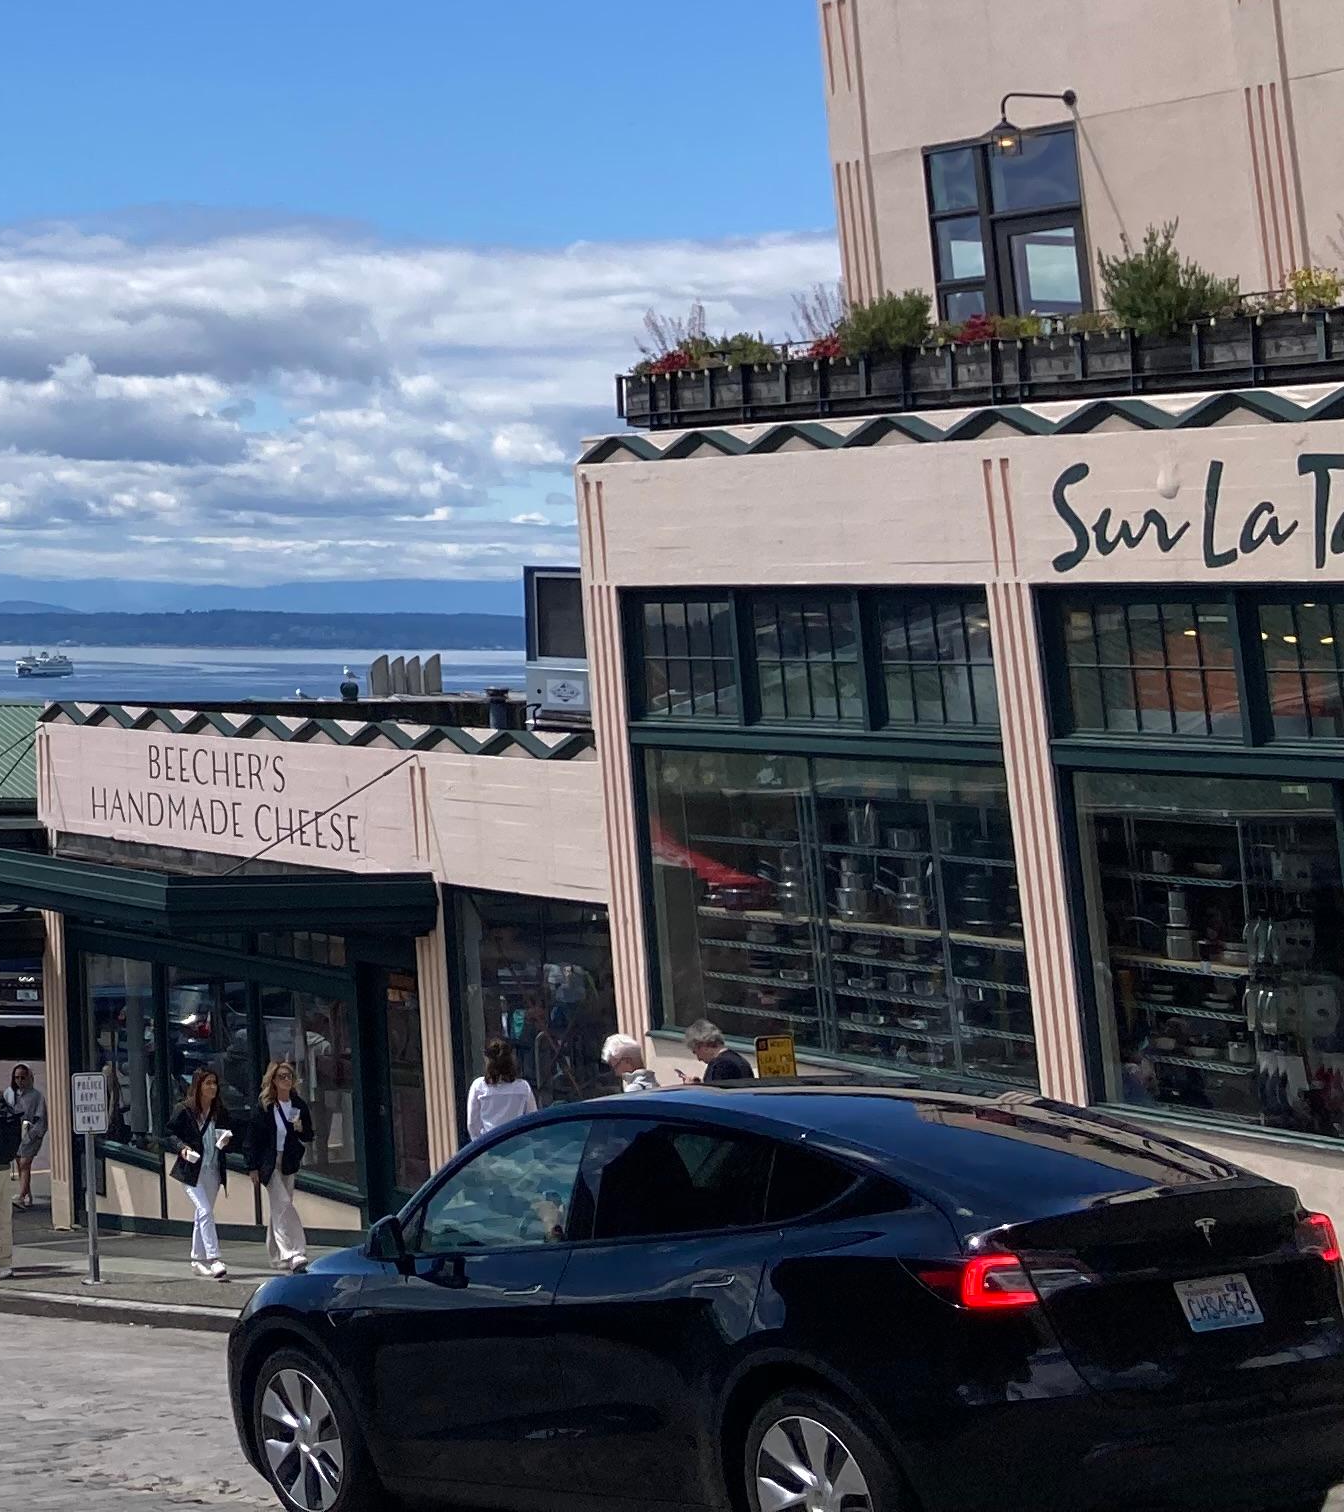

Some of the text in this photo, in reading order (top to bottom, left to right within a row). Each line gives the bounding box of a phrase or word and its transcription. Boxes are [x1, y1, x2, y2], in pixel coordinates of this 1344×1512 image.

[1052, 453, 1344, 573] Sur La T
[148, 744, 286, 793] BEECHER'S
[91, 786, 361, 853] HANDMADE CHEESE
[77, 1081, 102, 1090] POLICE
[76, 1103, 105, 1113] VEHICLES
[82, 1116, 100, 1124] ONLY
